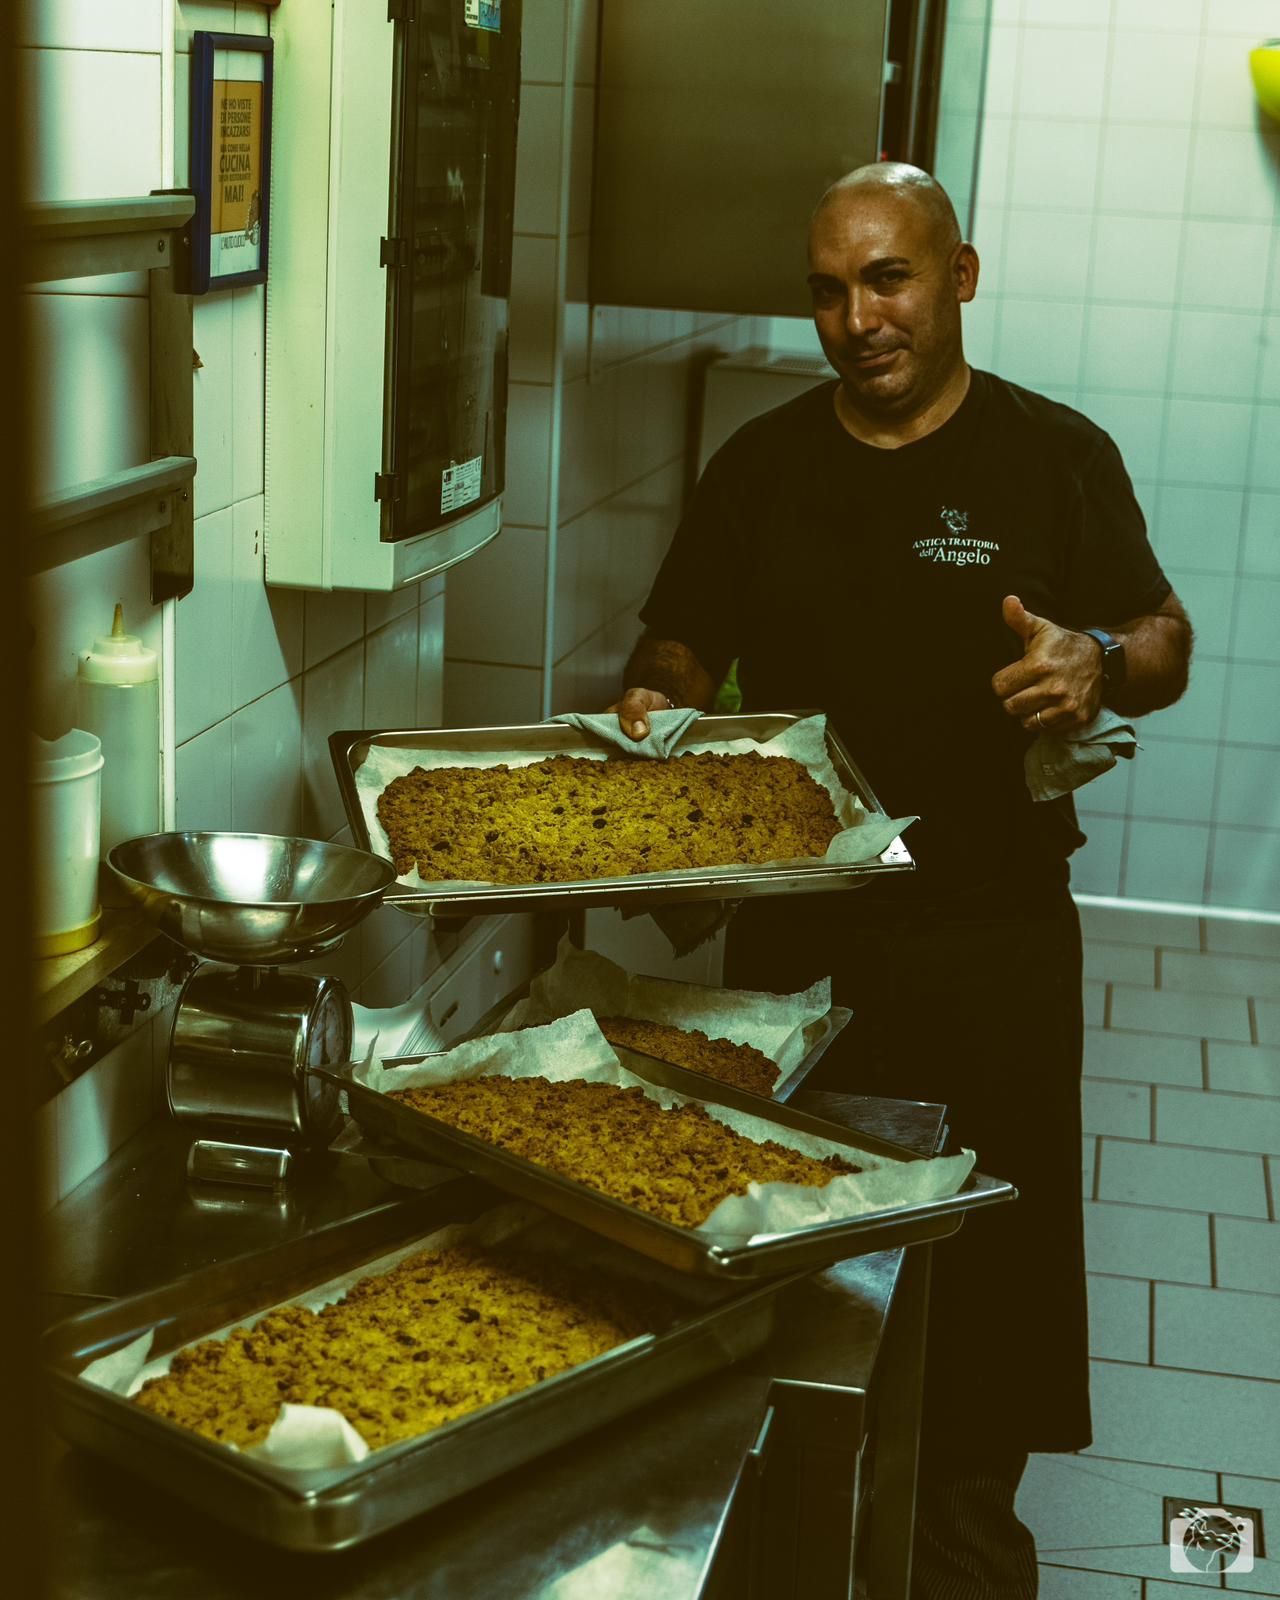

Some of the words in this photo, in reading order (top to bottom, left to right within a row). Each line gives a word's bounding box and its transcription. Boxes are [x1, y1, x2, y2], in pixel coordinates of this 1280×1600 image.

[229, 99, 236, 110] HO
[237, 99, 251, 110] VISTE
[228, 112, 251, 124] PERSONE
[221, 126, 250, 138] INCAZZARSI
[220, 154, 250, 173] CUCINA
[224, 185, 244, 203] MAI!
[912, 538, 946, 548] ANTICA
[948, 538, 999, 550] TRATTORIA
